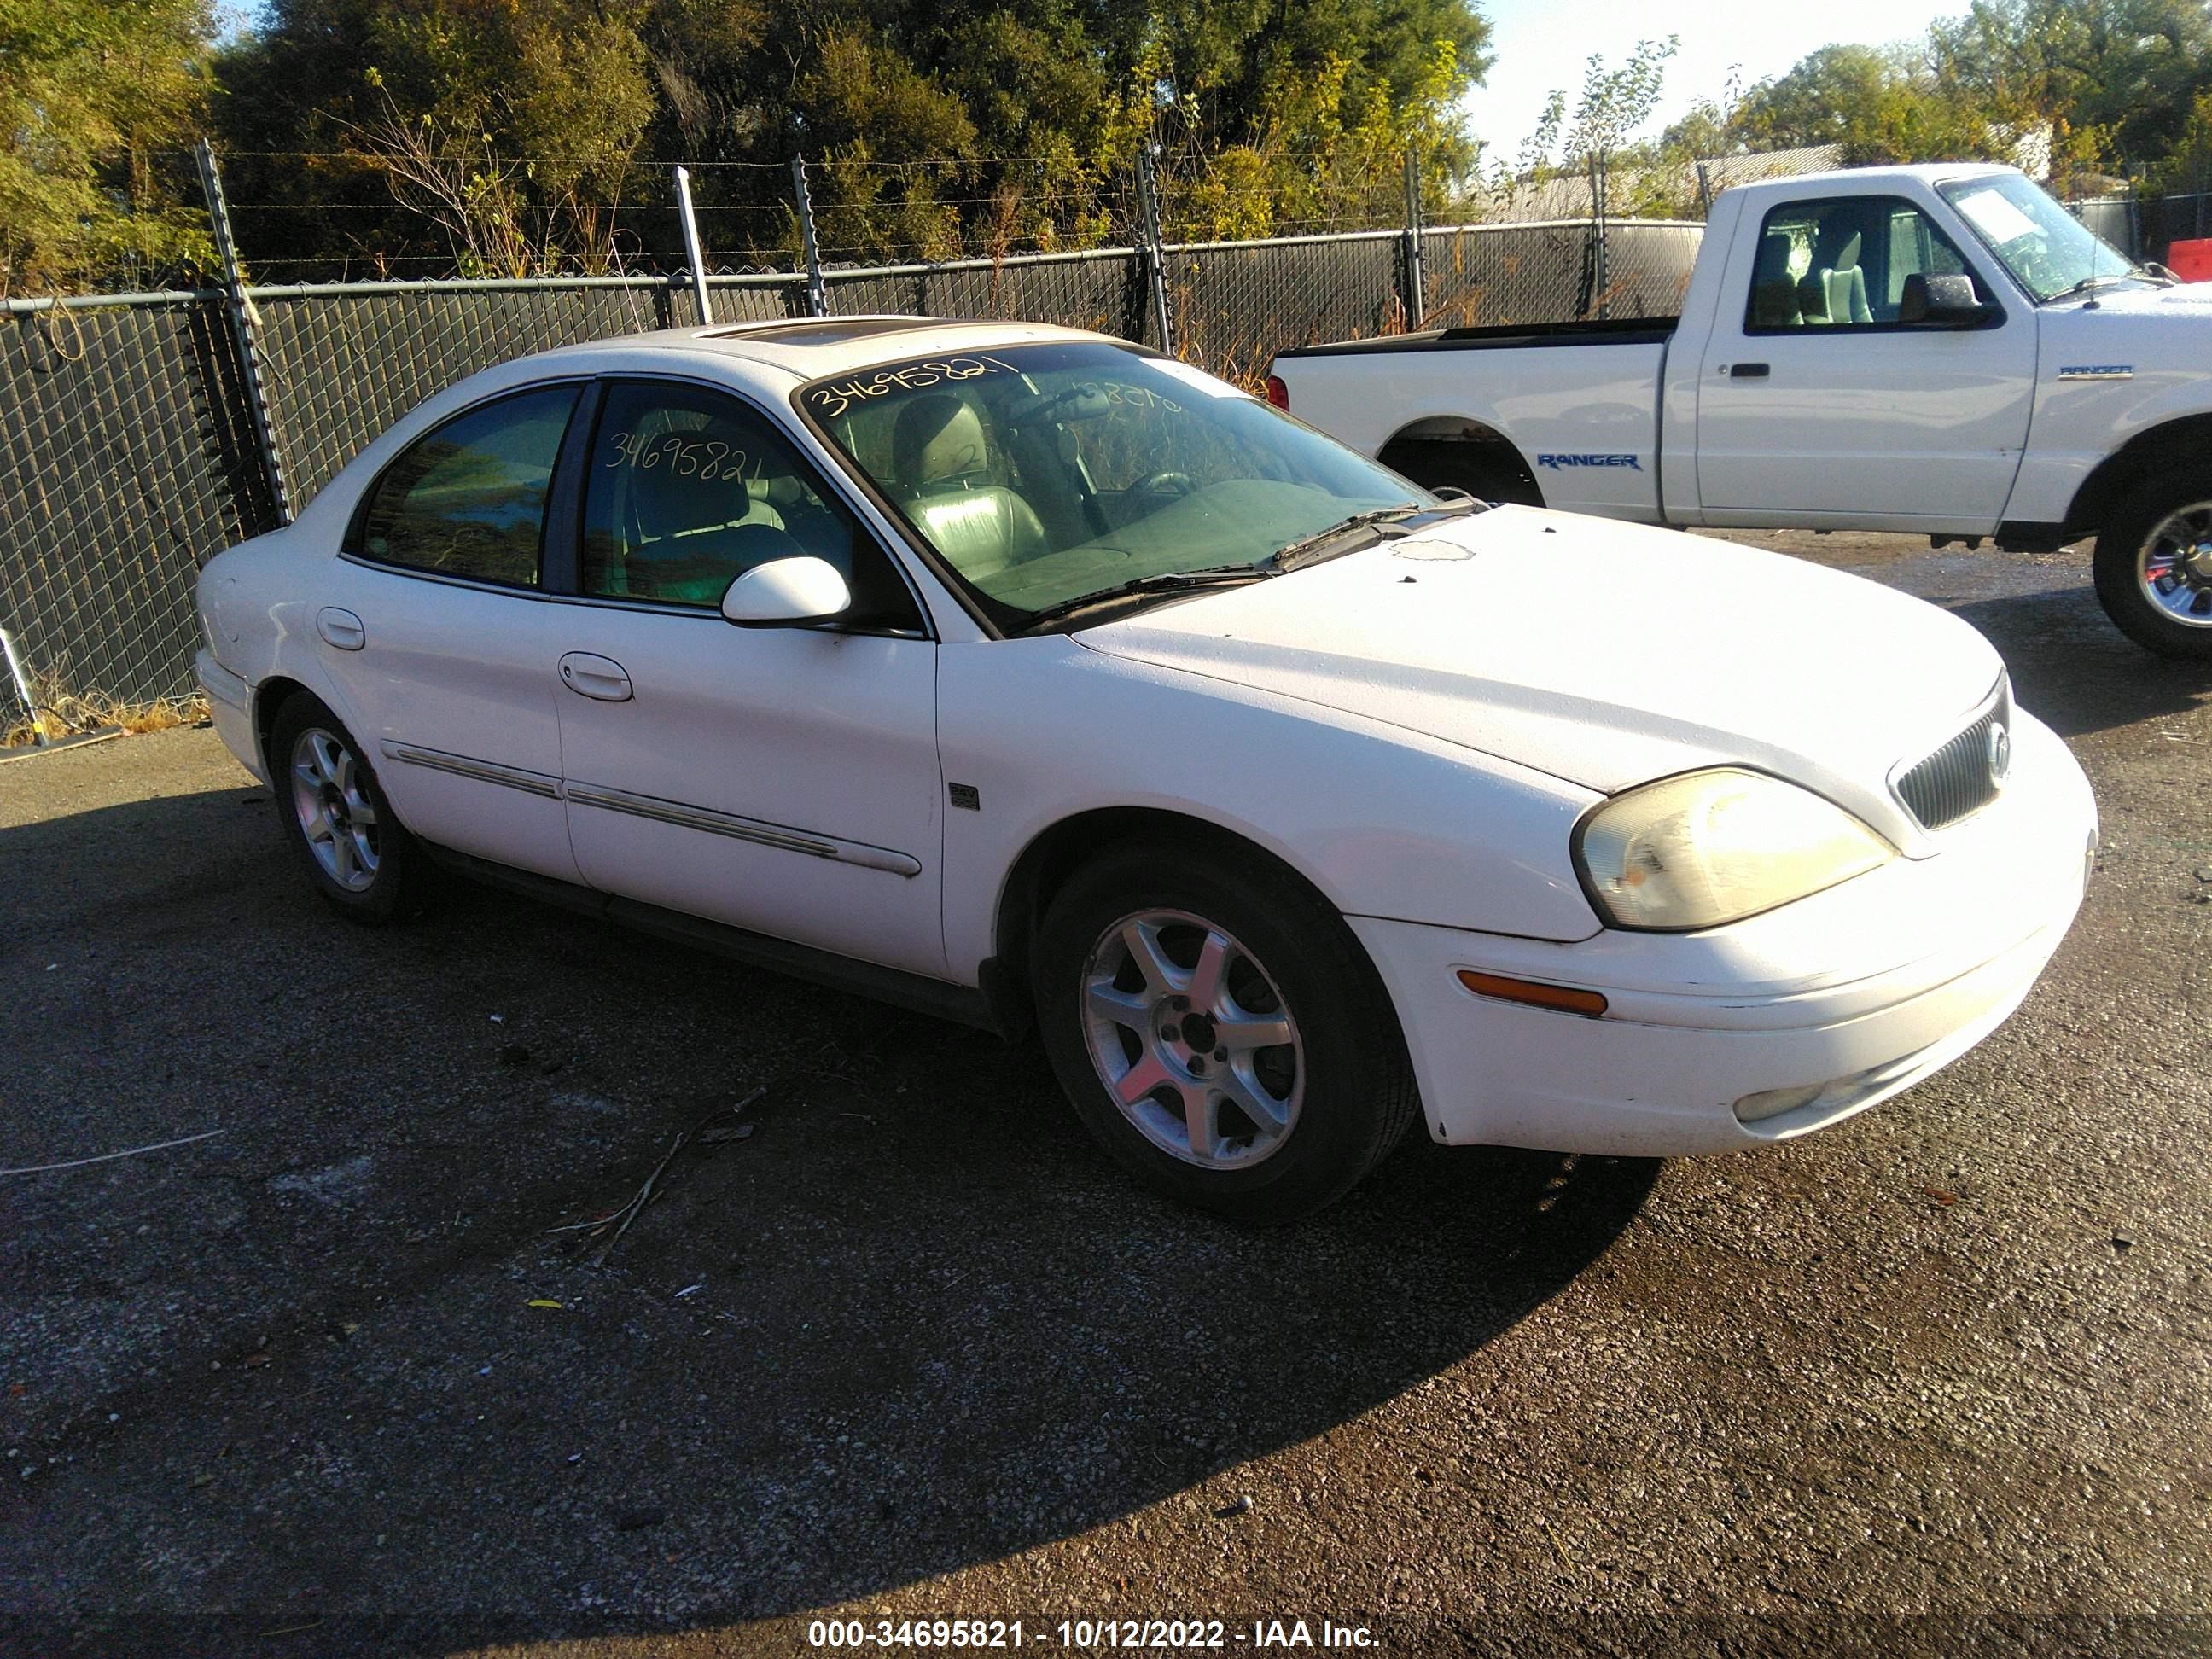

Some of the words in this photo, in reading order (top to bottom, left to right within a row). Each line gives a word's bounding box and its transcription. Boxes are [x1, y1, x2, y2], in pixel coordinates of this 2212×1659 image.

[811, 356, 1020, 417] 34695821
[2060, 365, 2132, 374] RANGER
[605, 432, 762, 490] 34695821
[1537, 453, 1644, 472] RANGER
